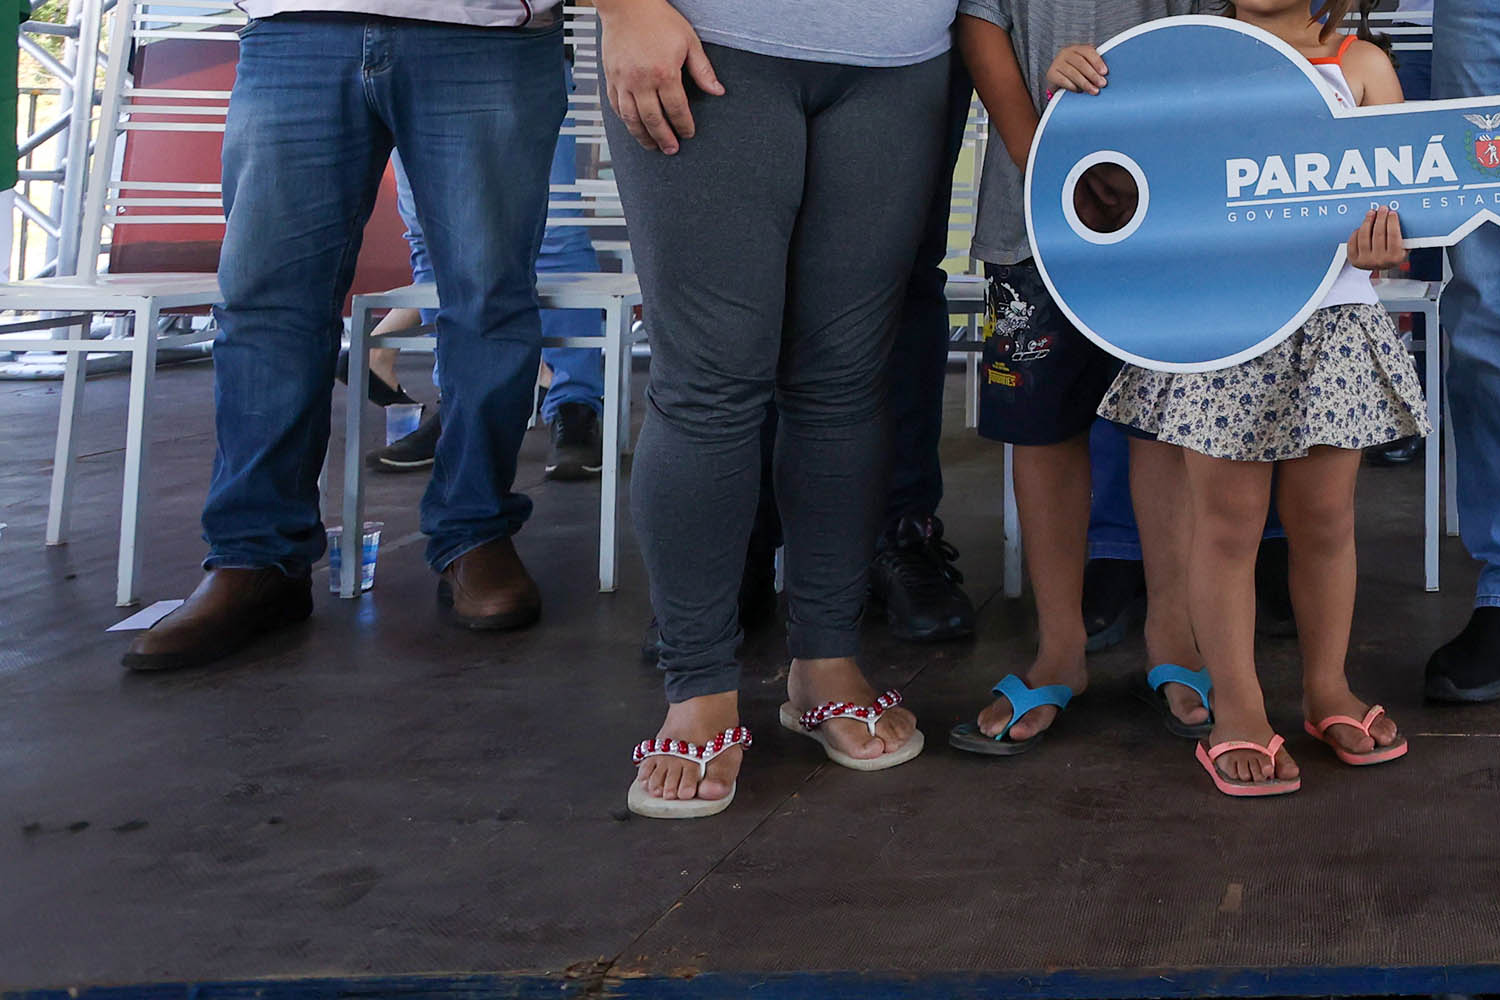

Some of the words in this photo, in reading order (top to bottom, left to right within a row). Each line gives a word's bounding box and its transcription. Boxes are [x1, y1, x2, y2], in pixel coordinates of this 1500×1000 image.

[1225, 134, 1458, 198] PARANÁ
[1227, 203, 1348, 223] GOVERNO
[1370, 200, 1400, 212] DO
